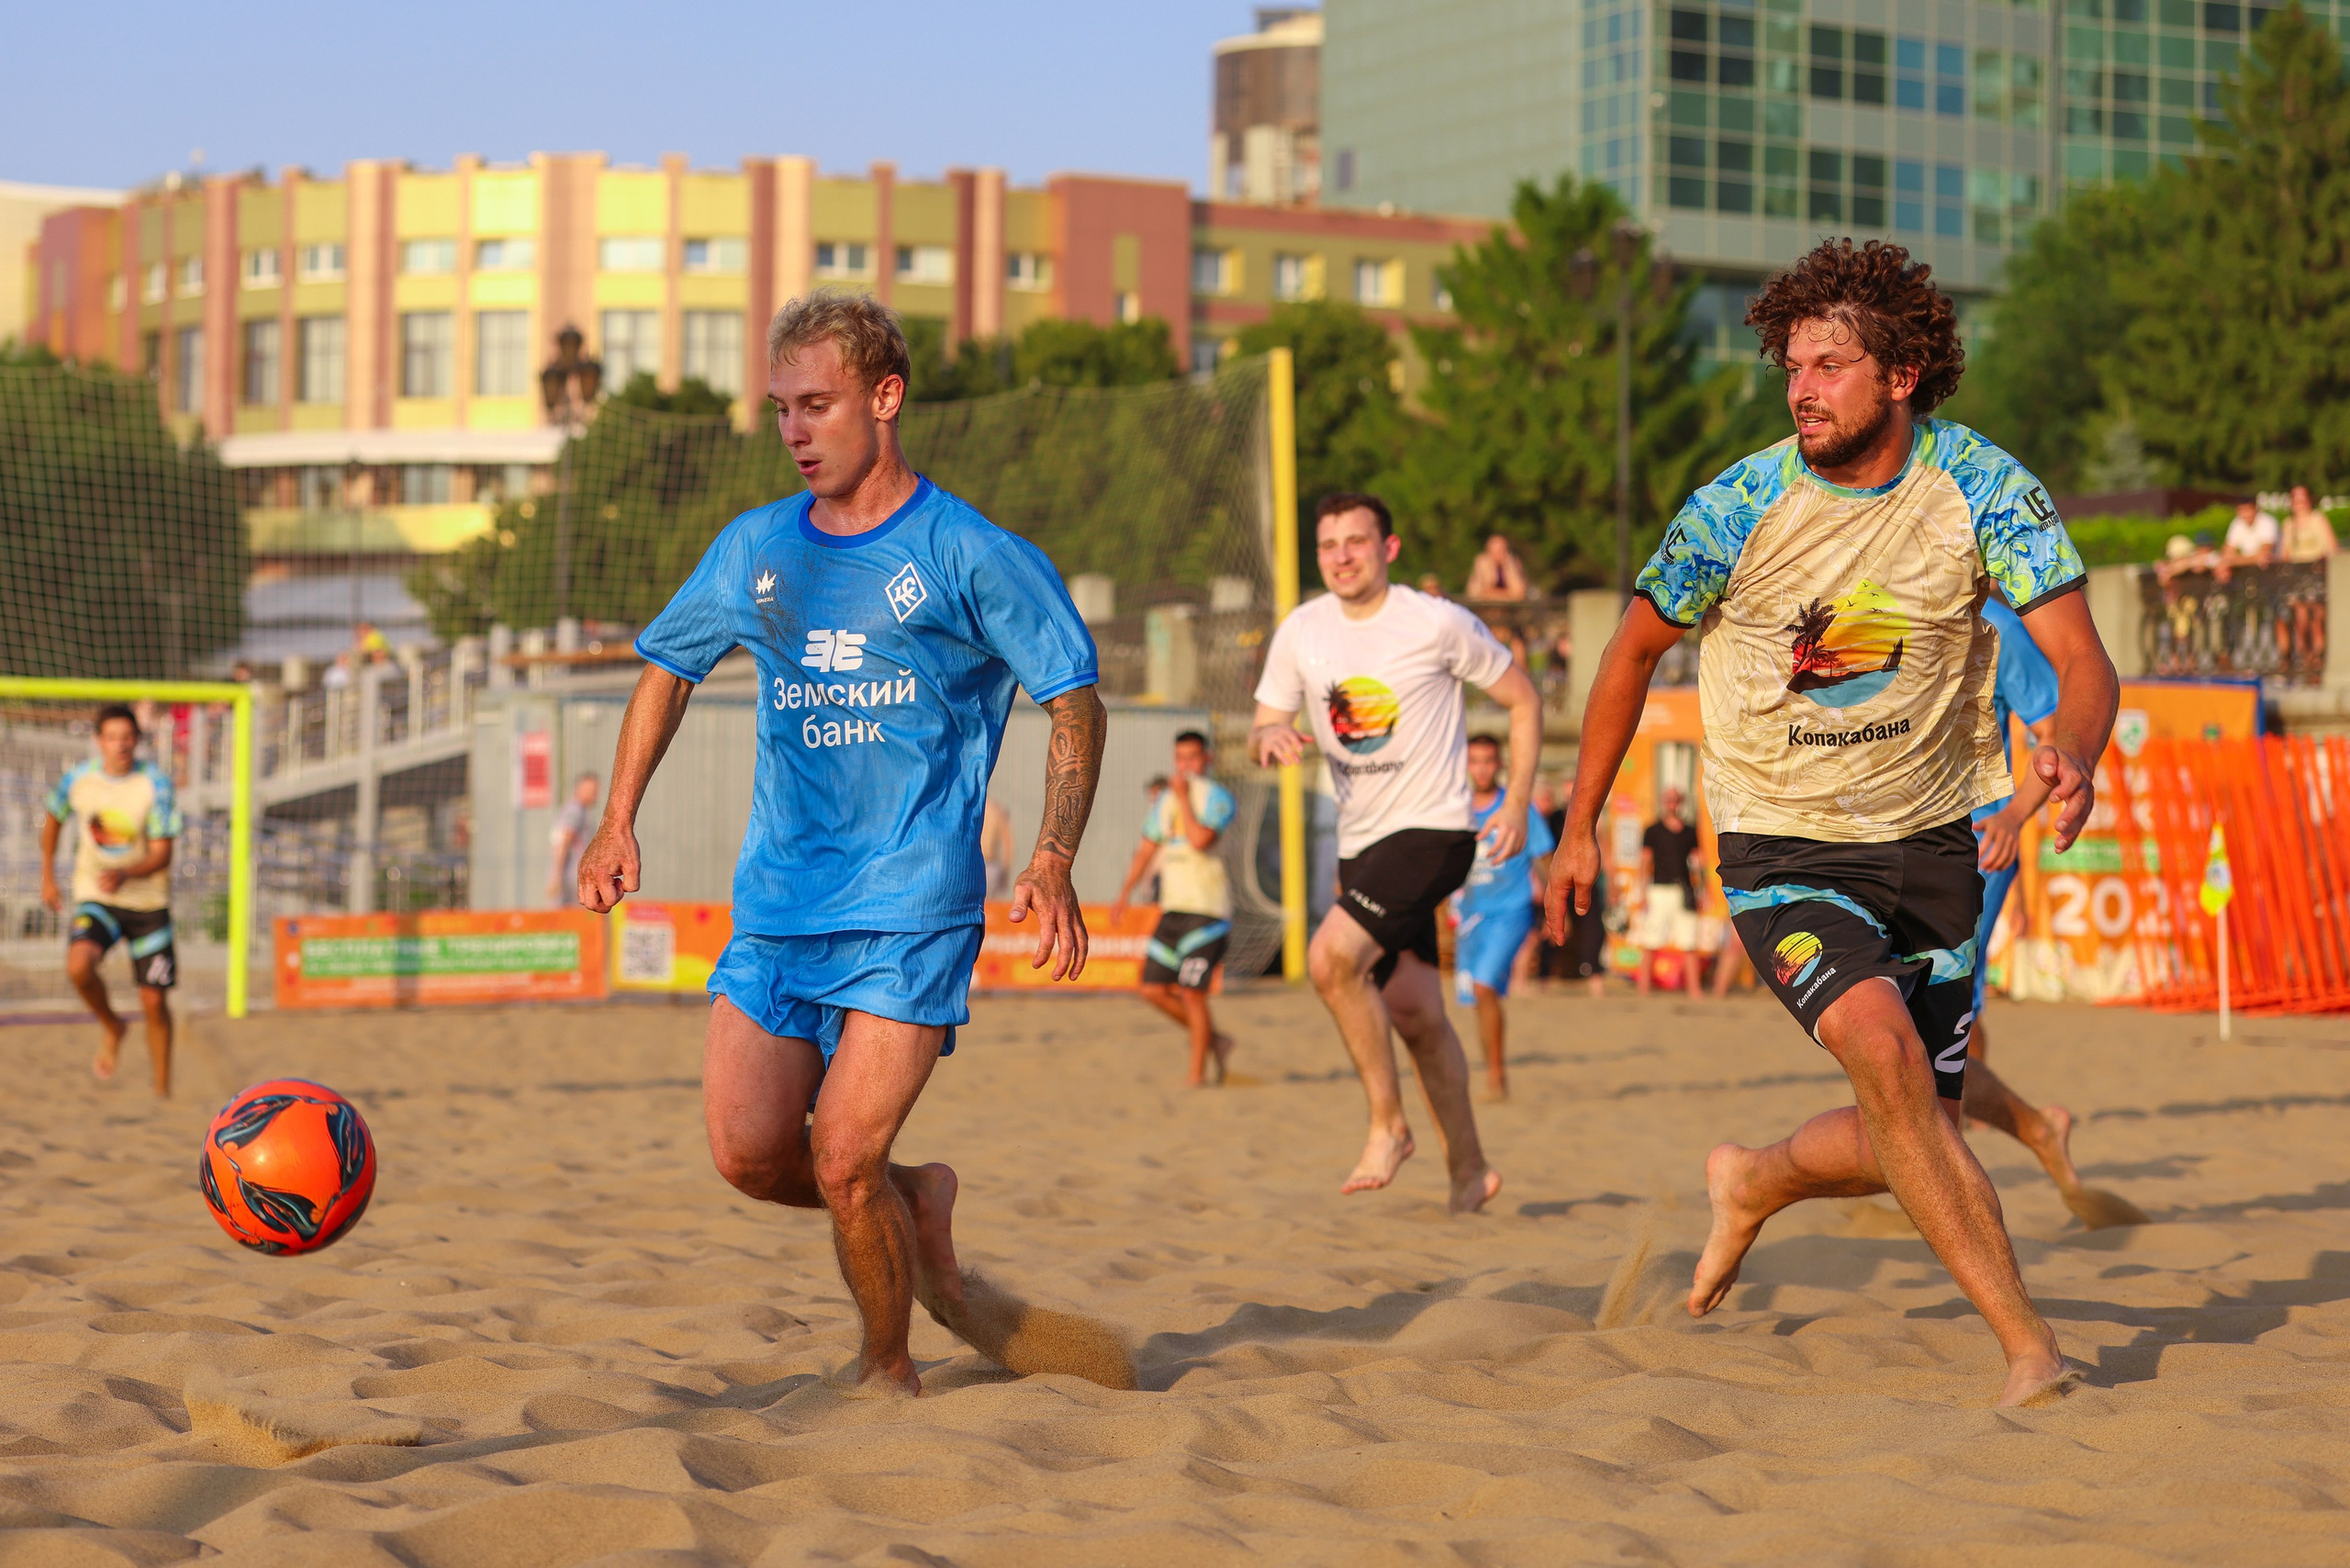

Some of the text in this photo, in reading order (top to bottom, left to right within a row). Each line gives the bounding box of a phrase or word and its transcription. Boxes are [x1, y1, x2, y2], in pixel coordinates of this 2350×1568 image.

[774, 668, 916, 711] Земский
[802, 714, 887, 749] банк
[1787, 718, 1911, 746] Копакабана
[1796, 967, 1837, 1009] Копакабана
